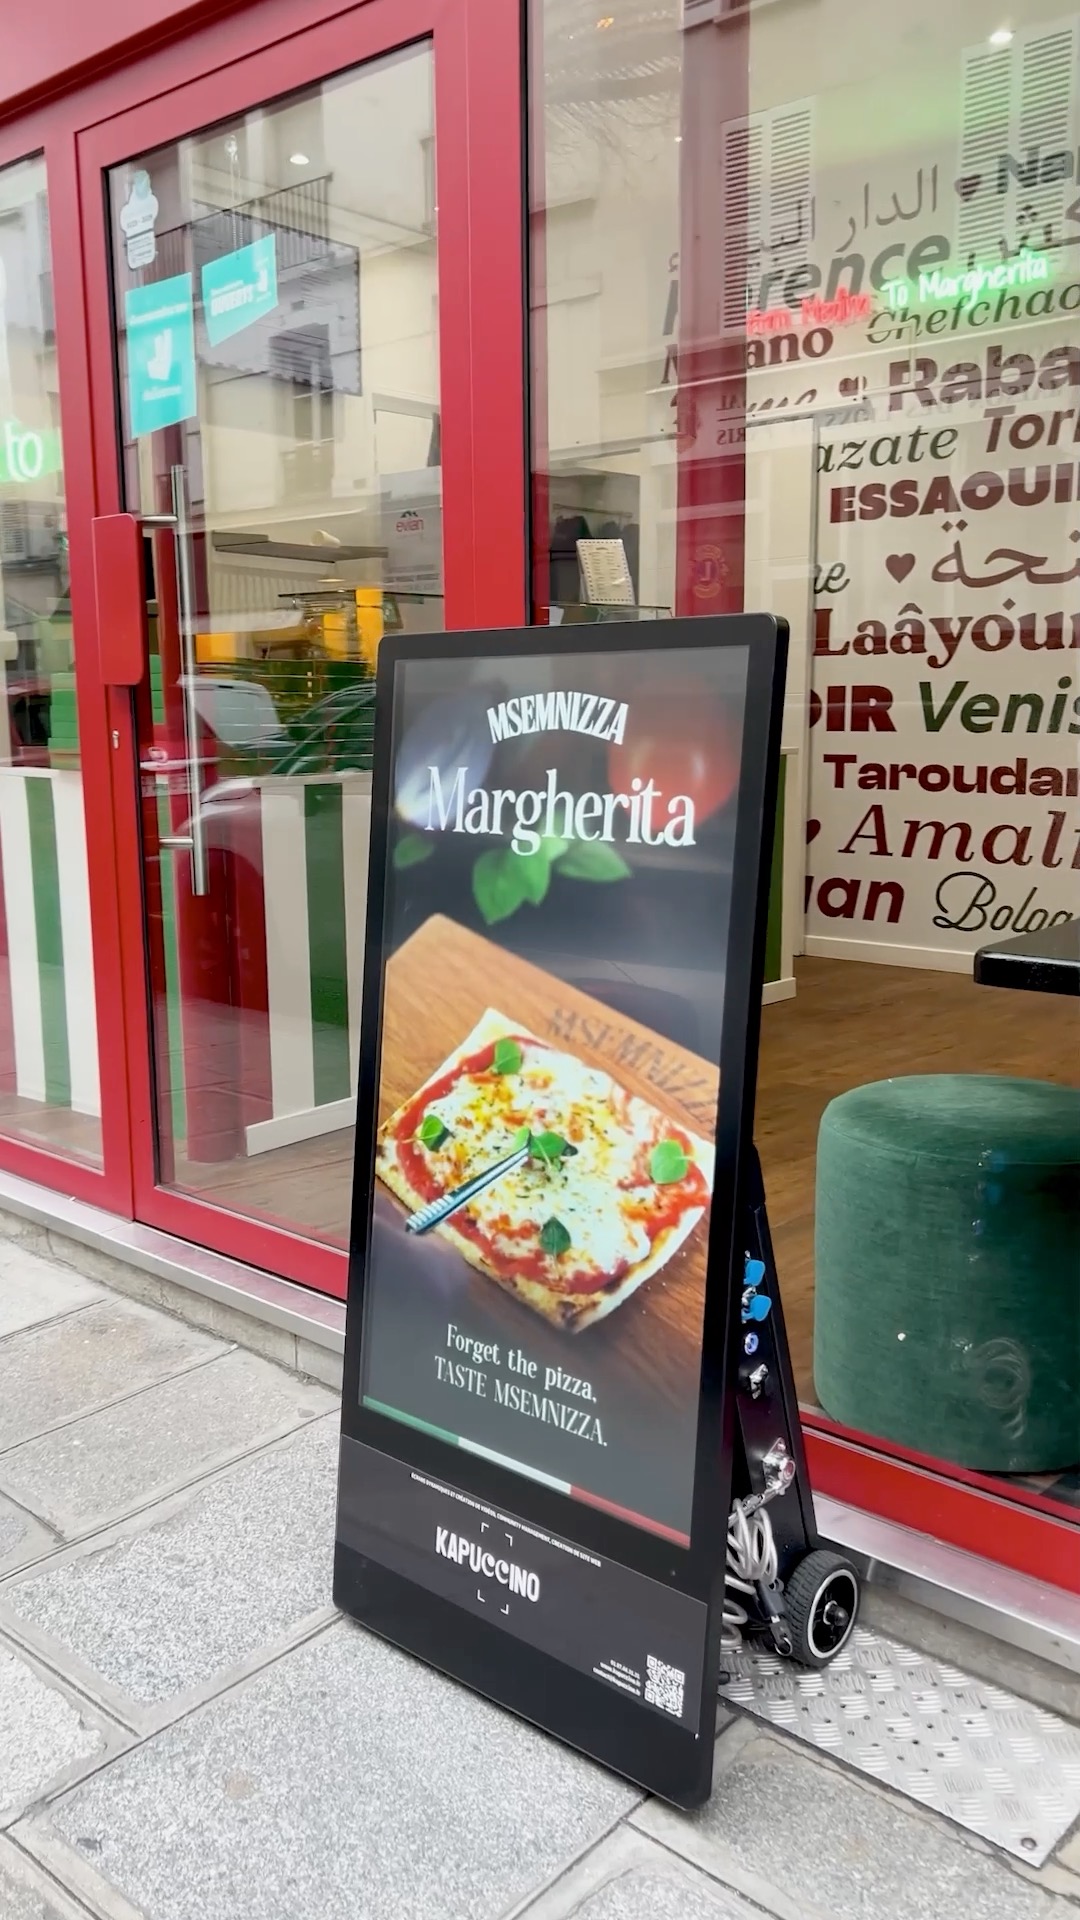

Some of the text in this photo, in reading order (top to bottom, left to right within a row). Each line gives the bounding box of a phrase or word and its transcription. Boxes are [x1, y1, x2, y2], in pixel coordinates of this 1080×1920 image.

[996, 146, 1080, 194] Na
[835, 164, 939, 252] الدار
[881, 279, 909, 308] To
[919, 249, 1049, 309] Margherita
[4, 422, 44, 481] to
[829, 462, 1080, 523] ESSAOUI
[396, 519, 424, 532] evian
[486, 691, 629, 745] MSEMNIZZA
[424, 766, 697, 856] Margherita
[447, 1323, 598, 1404] Forget the pizza,
[434, 1355, 608, 1447] TASTE MSEMNIZZA.
[435, 1525, 541, 1603] KAPUCCINO
